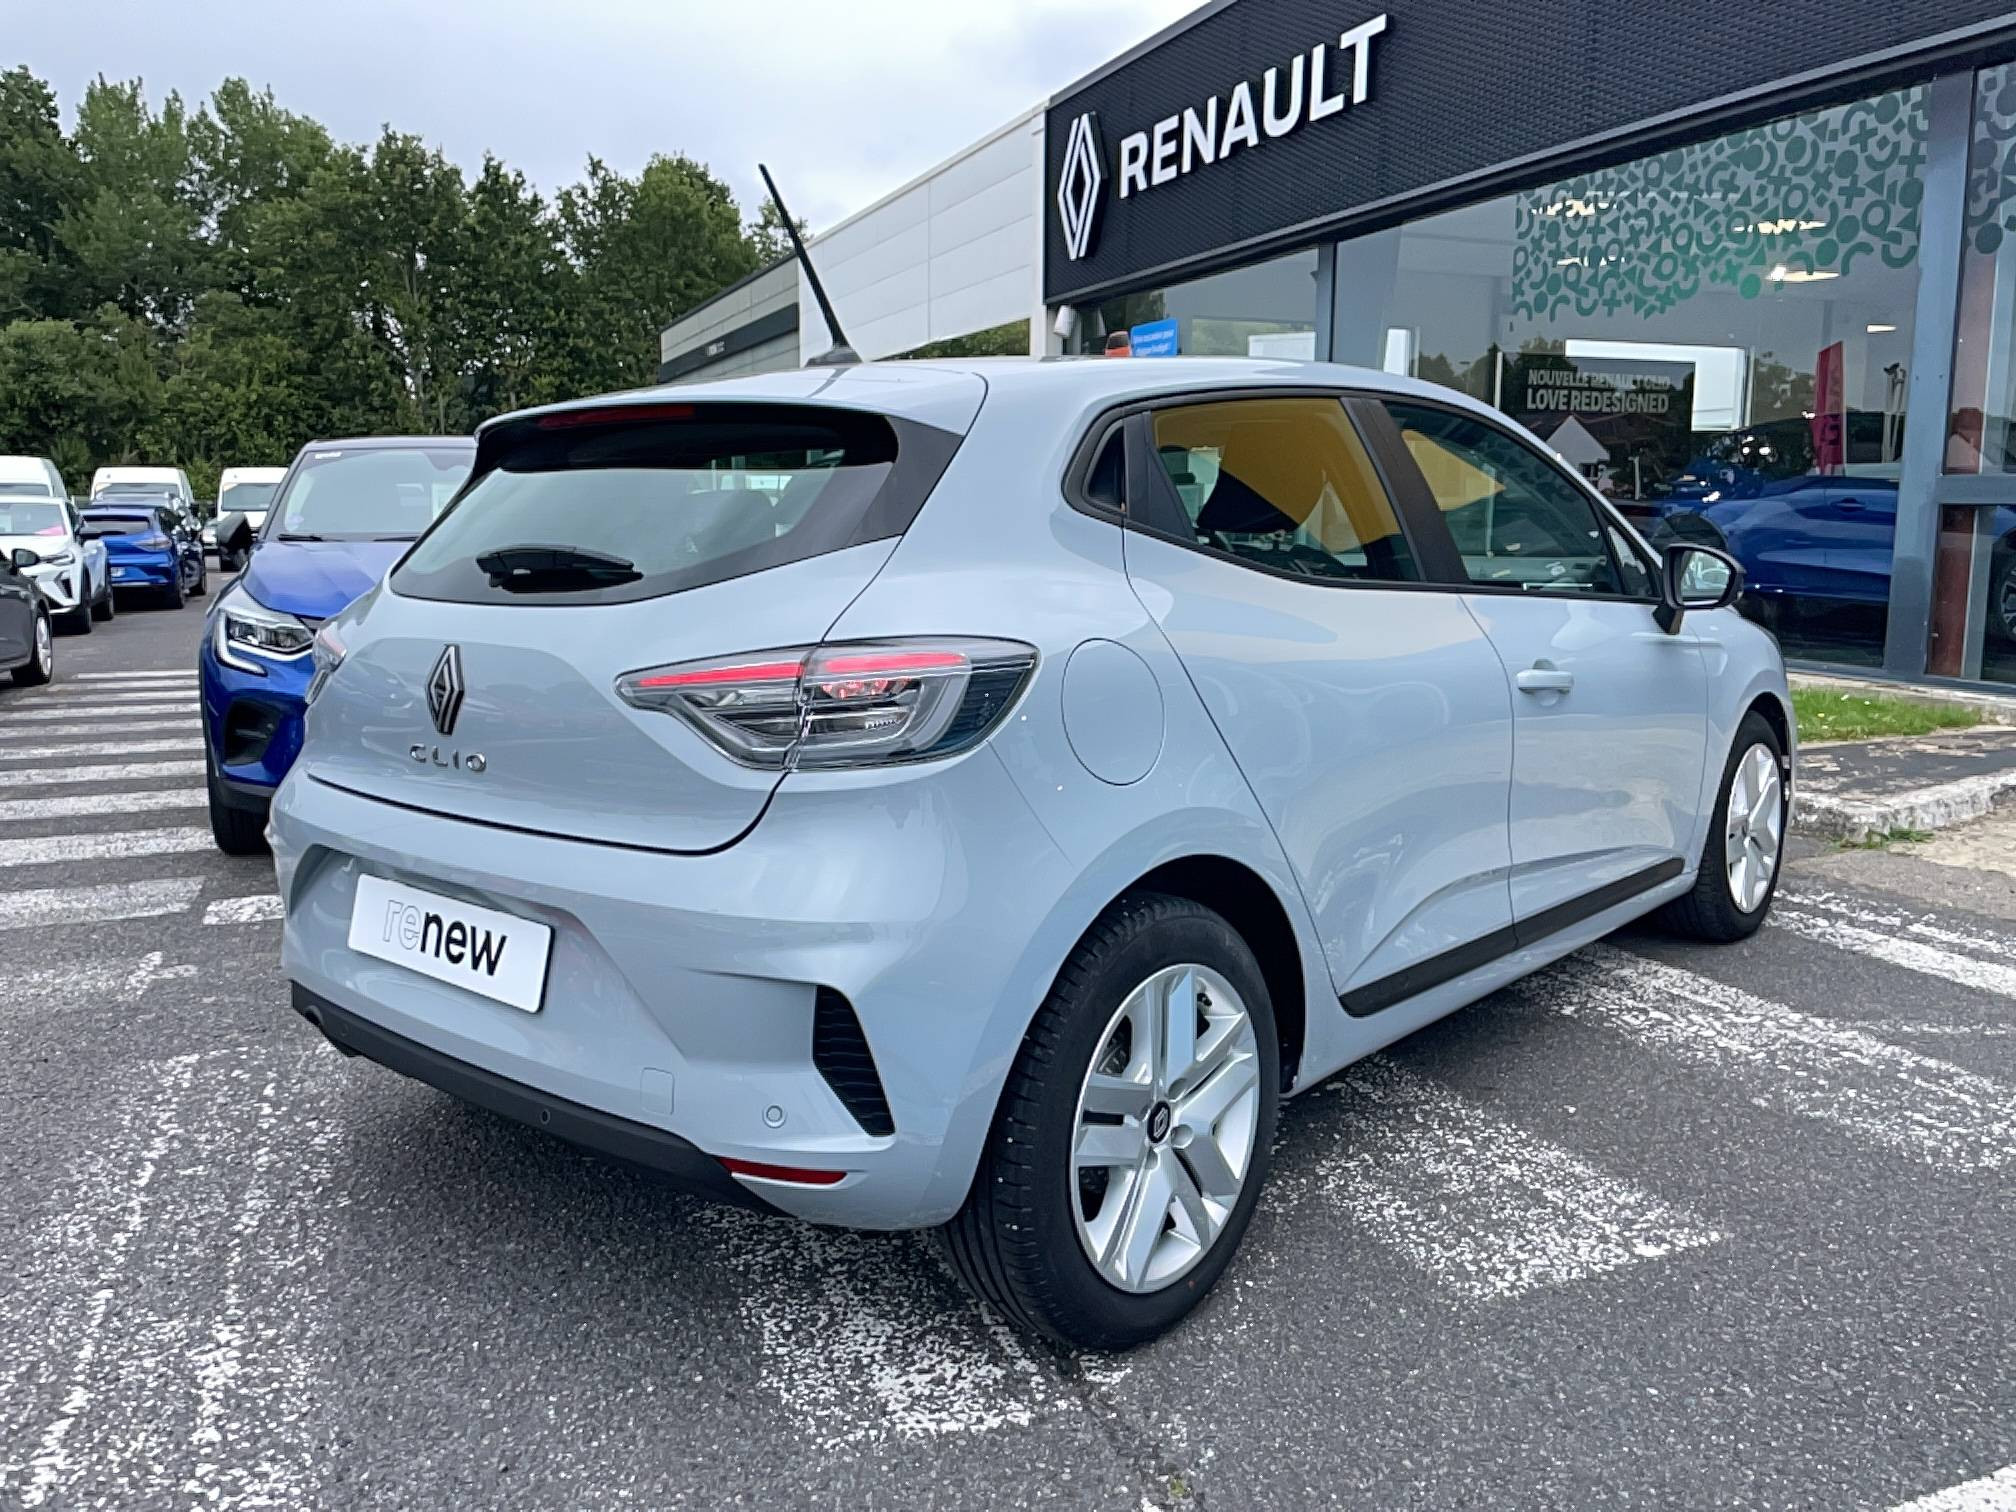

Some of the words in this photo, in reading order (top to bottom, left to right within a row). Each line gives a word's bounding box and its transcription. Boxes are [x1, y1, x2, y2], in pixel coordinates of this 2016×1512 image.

[1120, 14, 1387, 199] RENAULT
[1528, 370, 1588, 387] NOUVELLE
[1527, 389, 1568, 410] LOVE
[1571, 390, 1669, 413] REDESIGNED
[410, 744, 487, 772] CLIO
[383, 900, 507, 976] renew
